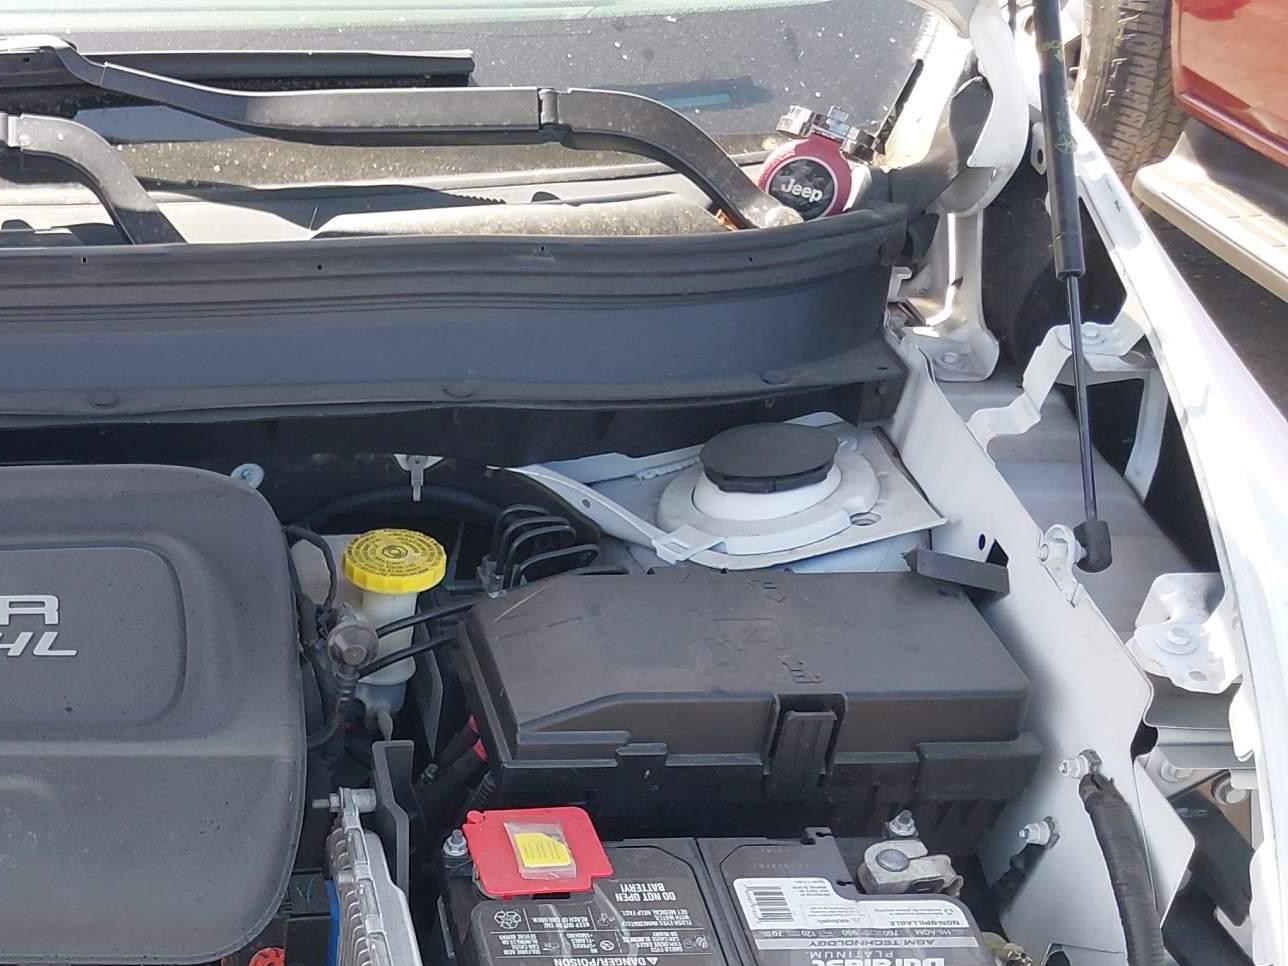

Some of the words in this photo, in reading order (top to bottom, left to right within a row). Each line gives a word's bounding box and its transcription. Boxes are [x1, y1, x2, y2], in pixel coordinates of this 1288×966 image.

[781, 179, 823, 203] Jeep
[620, 883, 665, 892] BATTERY!
[615, 893, 641, 901] OPEN
[643, 892, 661, 901] NOT
[662, 892, 676, 900] DO
[808, 939, 900, 947] TECHNOLOGY
[553, 957, 646, 966] DANGER/POISON
